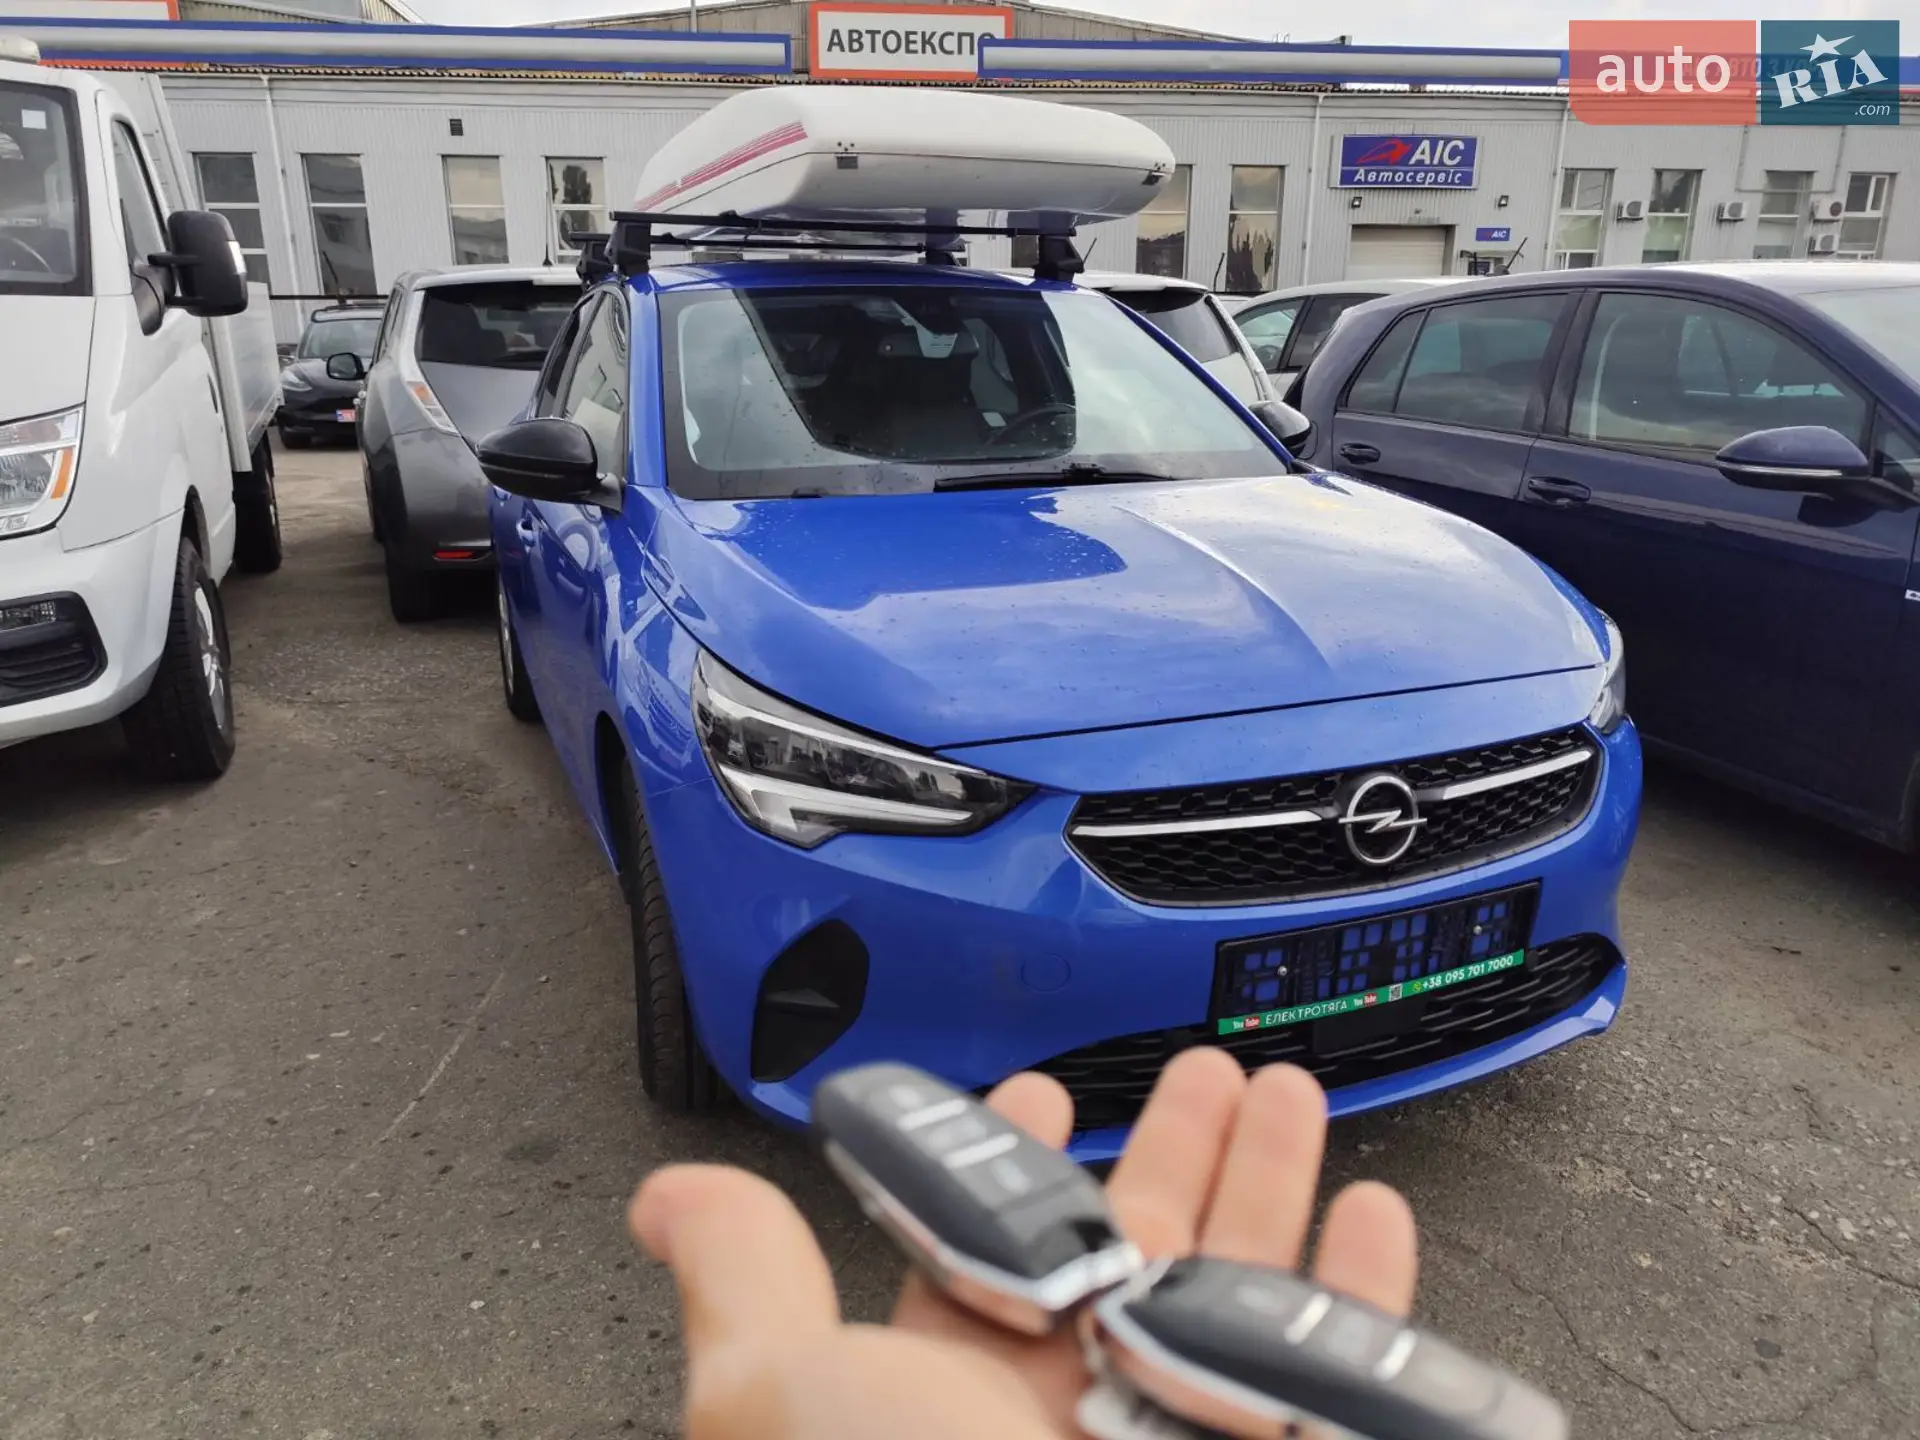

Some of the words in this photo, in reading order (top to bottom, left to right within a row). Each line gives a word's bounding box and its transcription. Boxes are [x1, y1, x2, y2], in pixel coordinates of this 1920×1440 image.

[1353, 168, 1462, 186] Автосервіс
[1423, 975, 1442, 989] +38
[1445, 969, 1465, 982] 095
[1468, 963, 1485, 977] 701
[1488, 955, 1514, 971] 7000
[1265, 1000, 1348, 1025] ЕЛЕКТРОТЯГА
